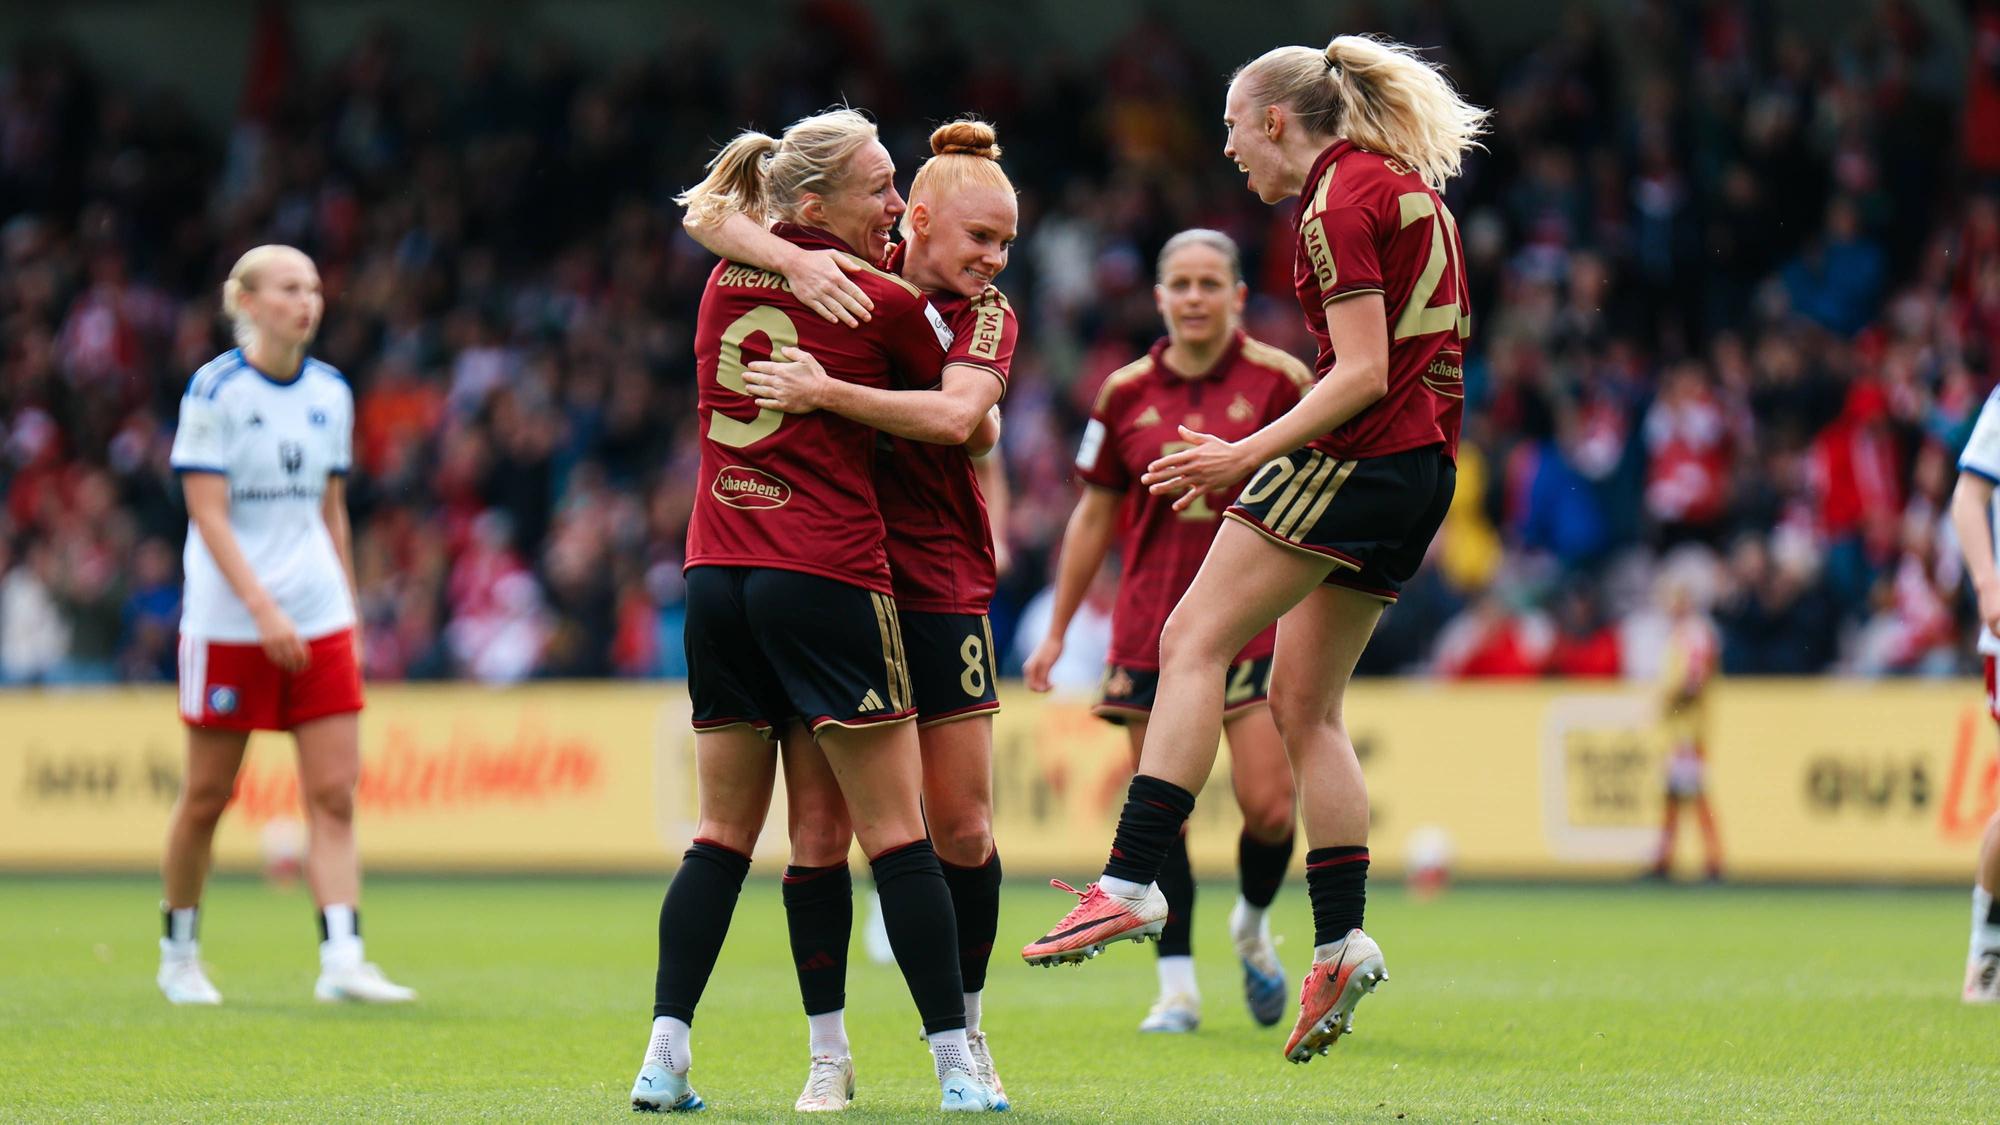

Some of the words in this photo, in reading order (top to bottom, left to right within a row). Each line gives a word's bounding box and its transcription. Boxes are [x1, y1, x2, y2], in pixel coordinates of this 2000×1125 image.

[1308, 227, 1333, 283] DEVK
[976, 312, 998, 354] DEVK
[707, 305, 798, 448] 9
[720, 475, 781, 497] Schaebens
[960, 634, 985, 697] 8
